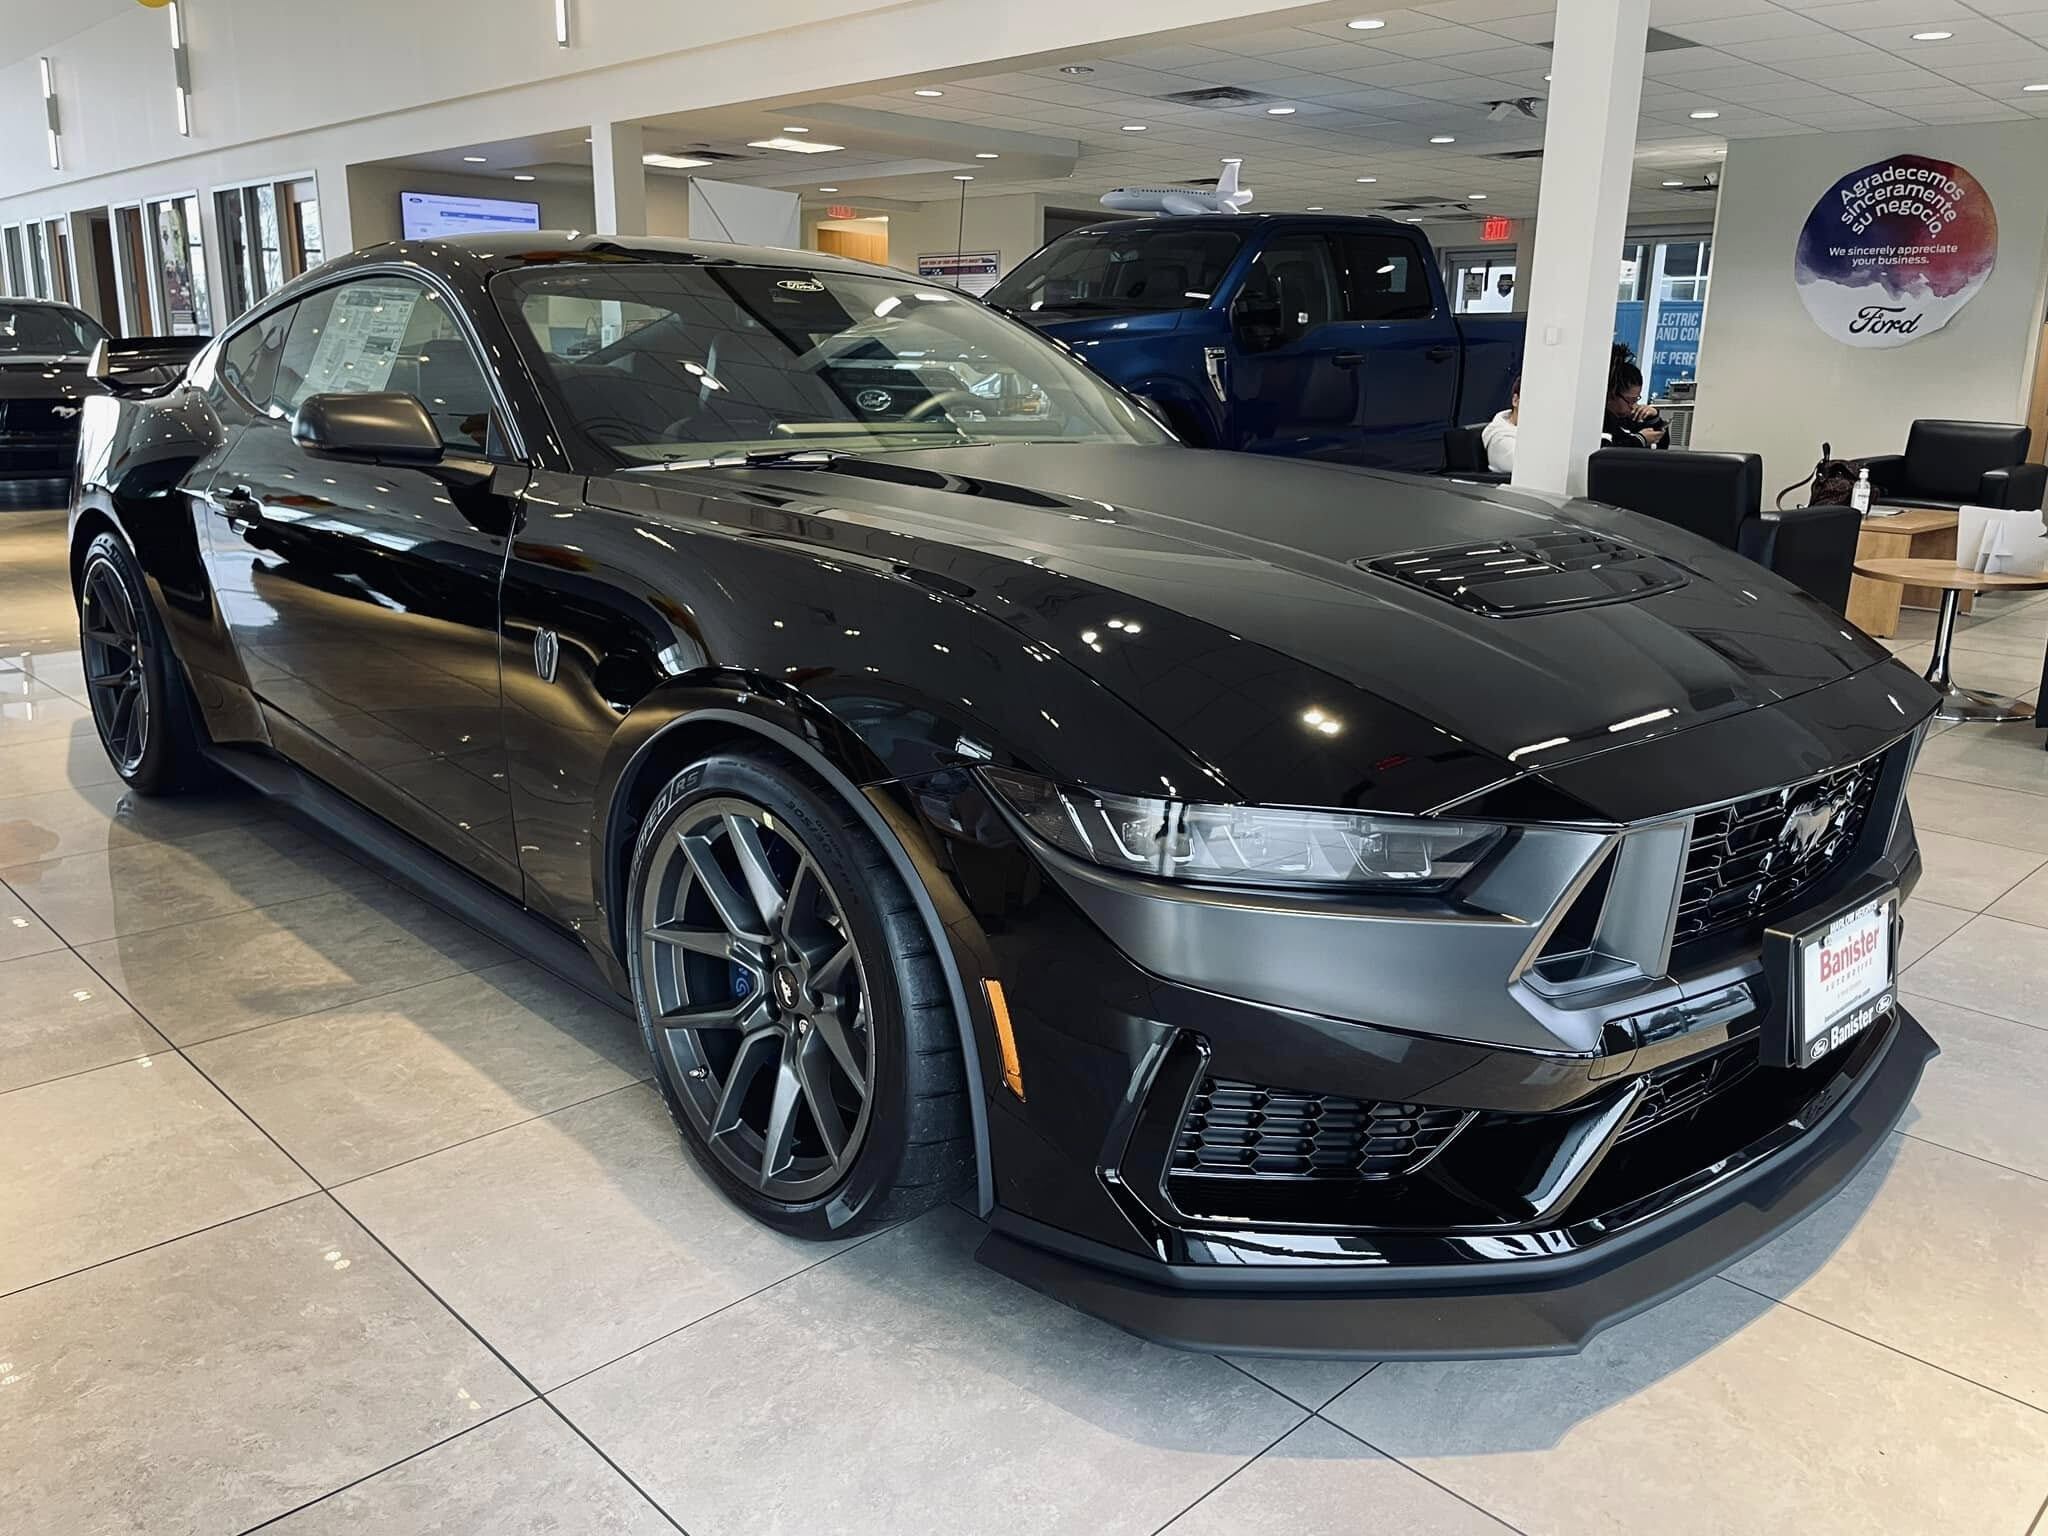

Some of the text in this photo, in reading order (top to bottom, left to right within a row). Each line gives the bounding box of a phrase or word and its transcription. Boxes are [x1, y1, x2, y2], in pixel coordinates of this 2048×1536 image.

[1841, 166, 1965, 205] Agradecemos
[1841, 184, 1957, 225] sinceramente
[1485, 220, 1508, 239] EXIT
[1852, 200, 1942, 239] su negocio.
[1829, 244, 1958, 257] We sincerely appreciate
[1852, 255, 1930, 268] your business.
[1657, 312, 1699, 326] LECTRIC
[1849, 306, 1923, 334] Ford
[1656, 327, 1679, 341] AND
[1653, 352, 1697, 366] HE PERF
[675, 771, 699, 794] RS
[1820, 928, 1880, 982] Banister
[1831, 1006, 1874, 1050] Banister
